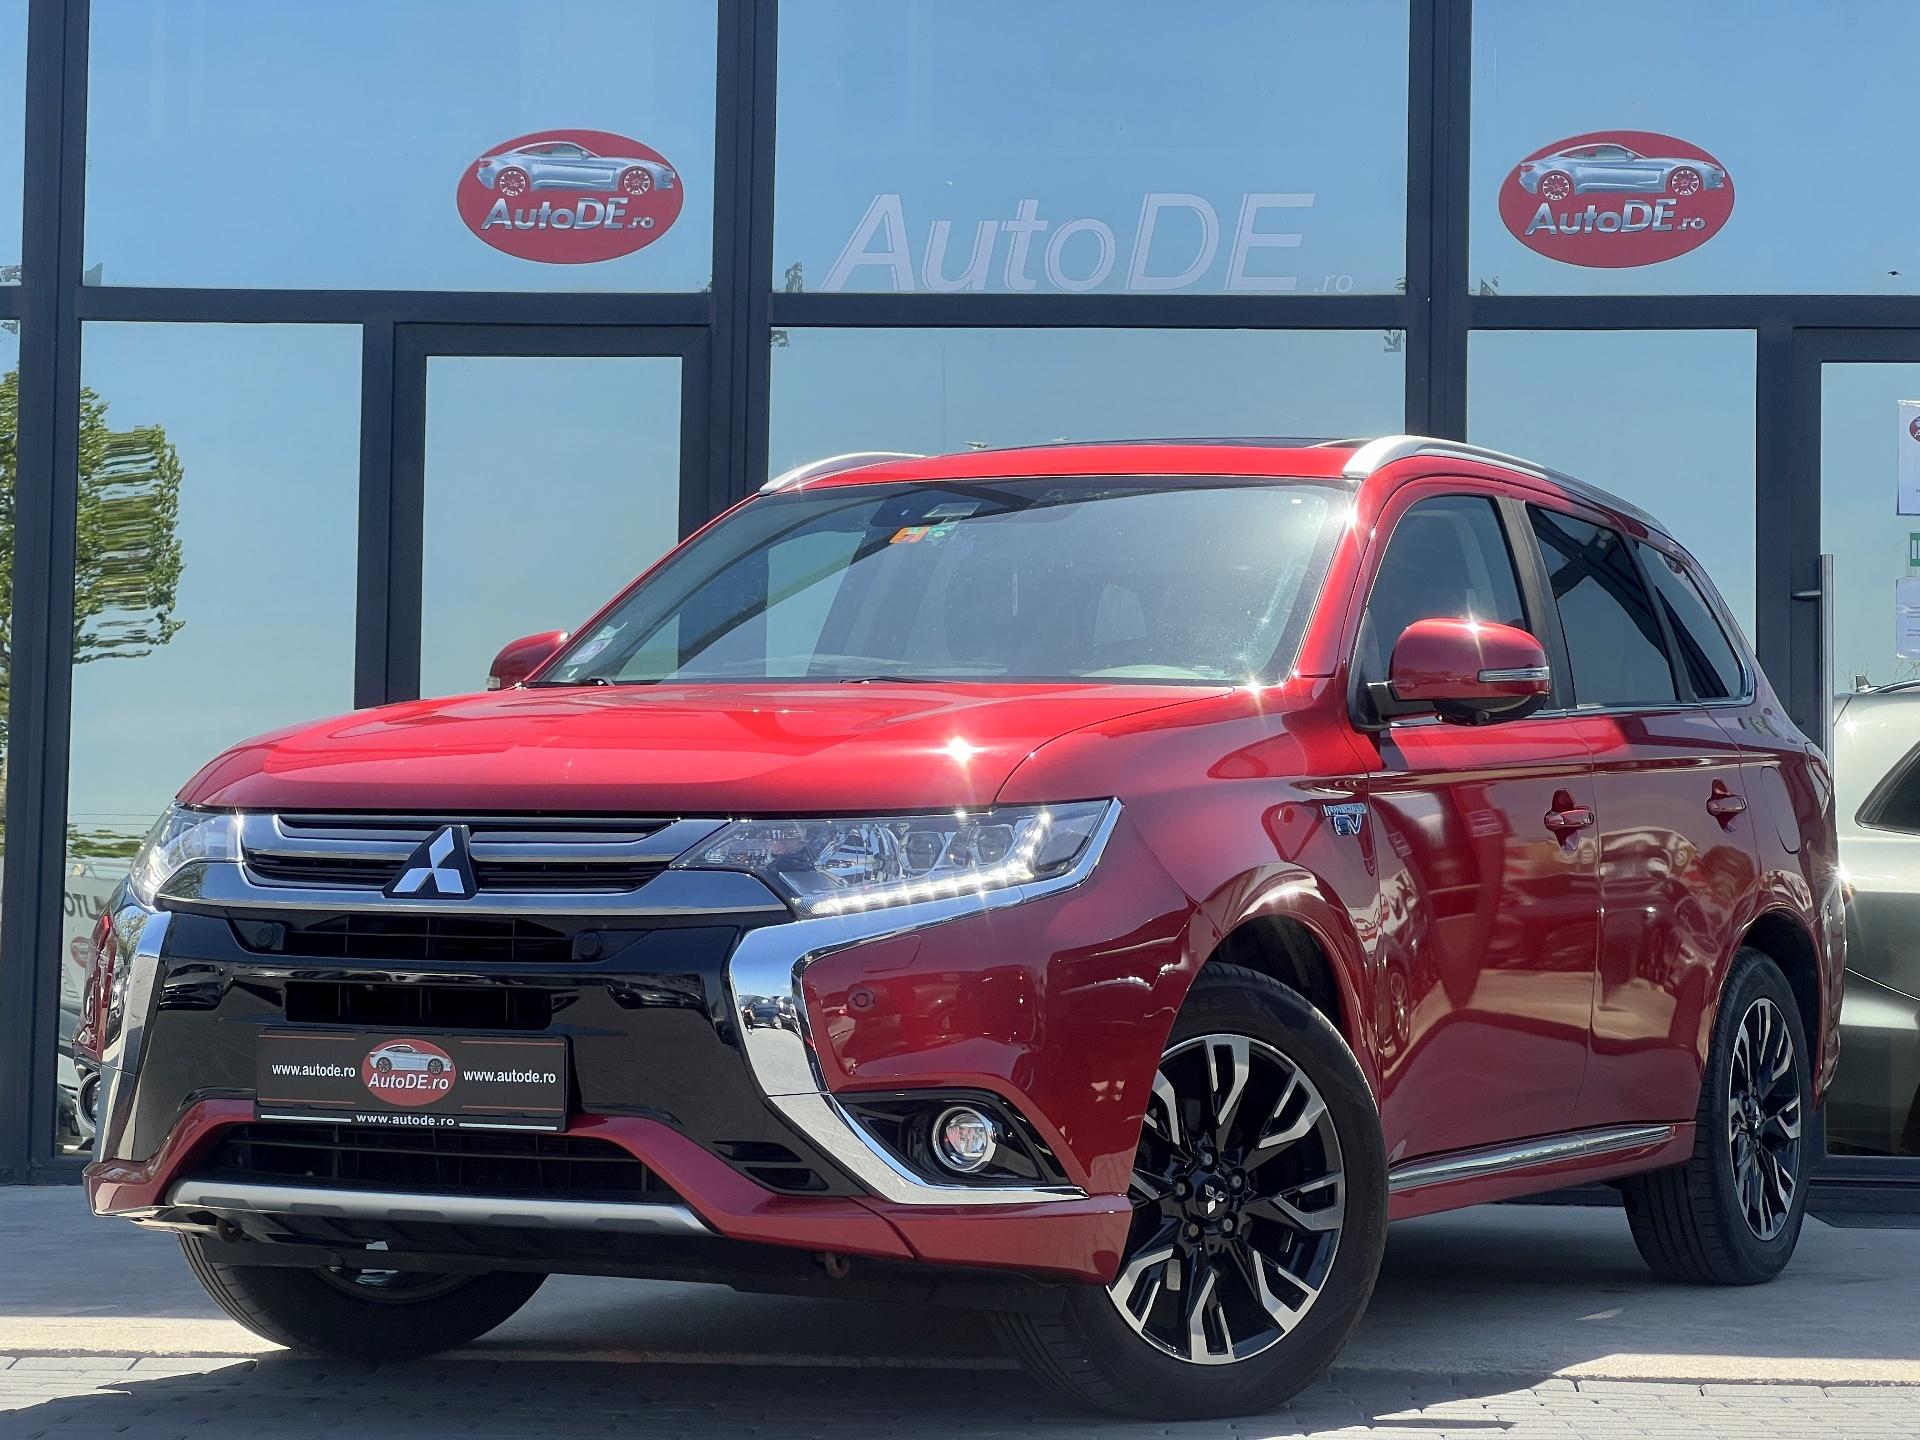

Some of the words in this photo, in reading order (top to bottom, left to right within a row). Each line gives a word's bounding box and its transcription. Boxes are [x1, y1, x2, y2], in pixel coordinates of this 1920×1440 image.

[271, 1063, 356, 1078] www.autode.ro
[463, 1068, 557, 1084] www.autode.ro
[368, 1072, 449, 1091] AutoDE.ro
[356, 1113, 455, 1126] www.autode.ro
